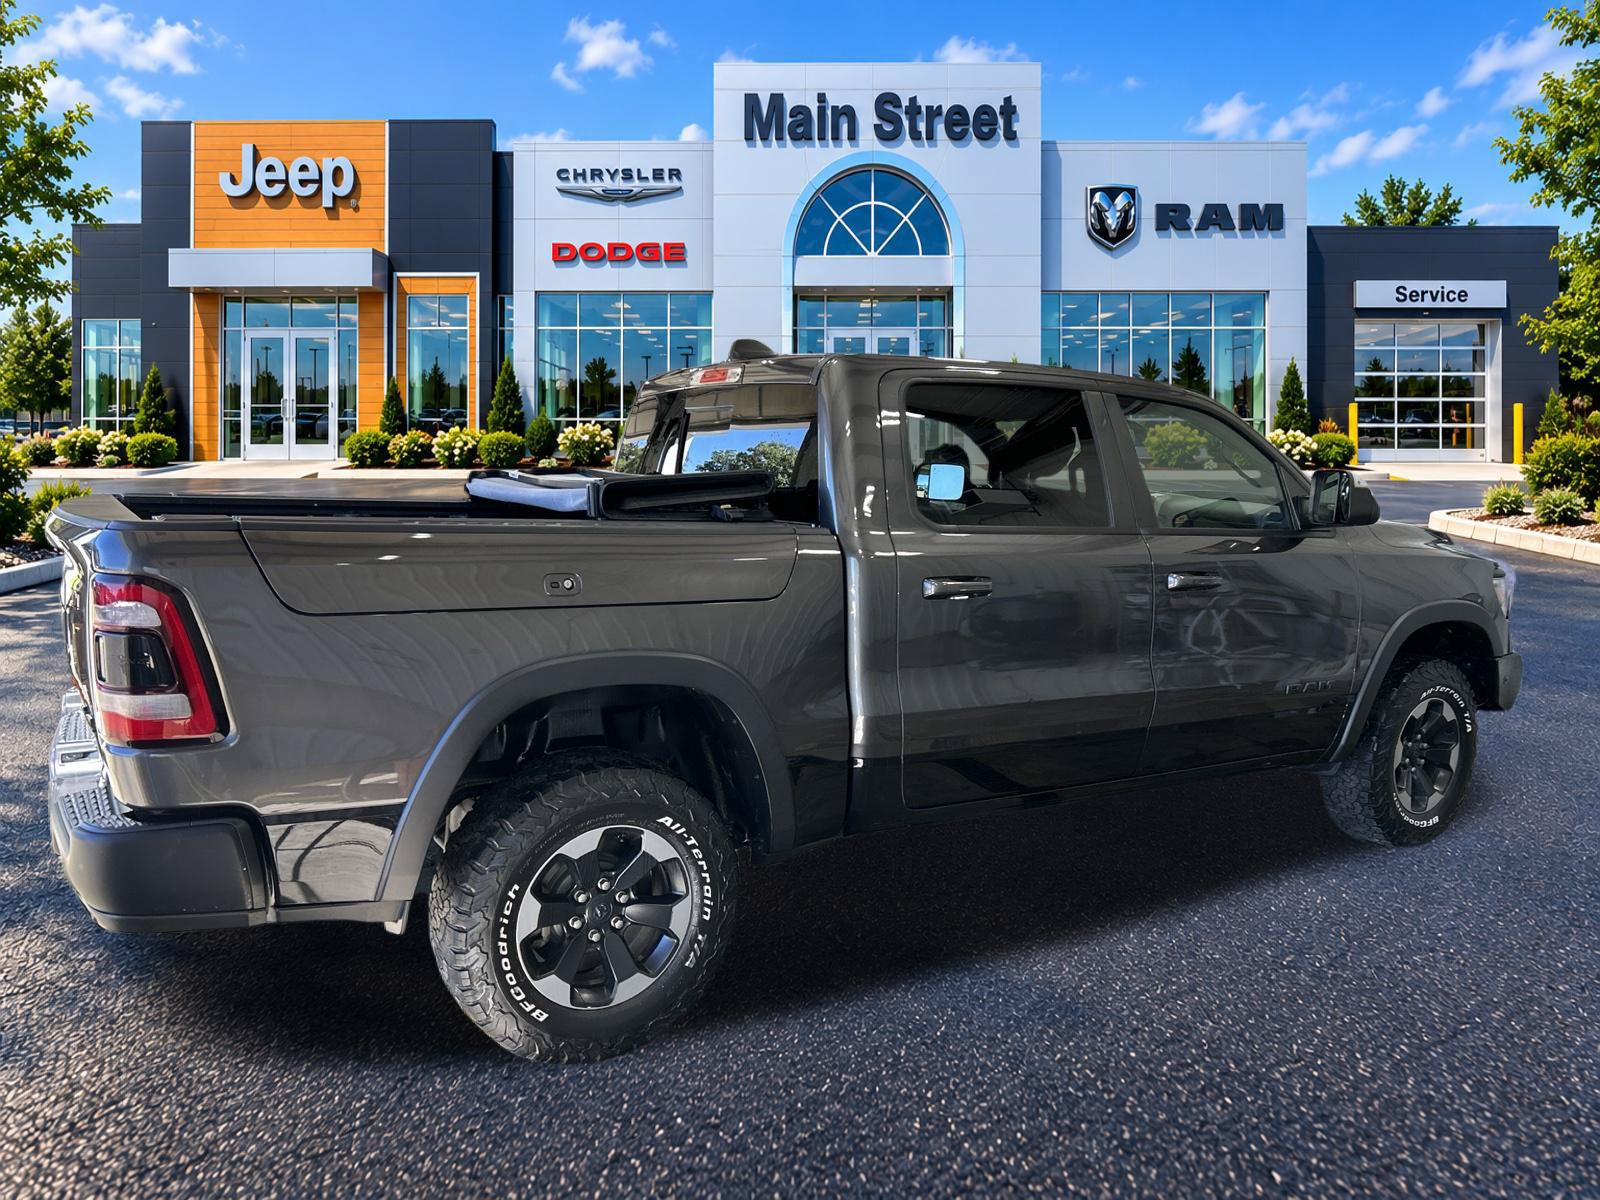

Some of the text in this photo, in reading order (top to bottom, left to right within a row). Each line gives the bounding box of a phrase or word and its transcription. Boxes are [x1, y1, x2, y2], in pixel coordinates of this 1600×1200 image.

[744, 92, 1017, 141] Main Street
[218, 143, 354, 208] Jeep
[556, 168, 683, 182] CHRYSLER
[1155, 203, 1284, 231] RAM
[551, 242, 687, 261] DODGE
[1395, 285, 1469, 303] Service
[1420, 685, 1473, 733] All-Terrain T/A
[656, 815, 713, 968] All-Terrain T/A
[497, 883, 550, 1023] BFGoodrich
